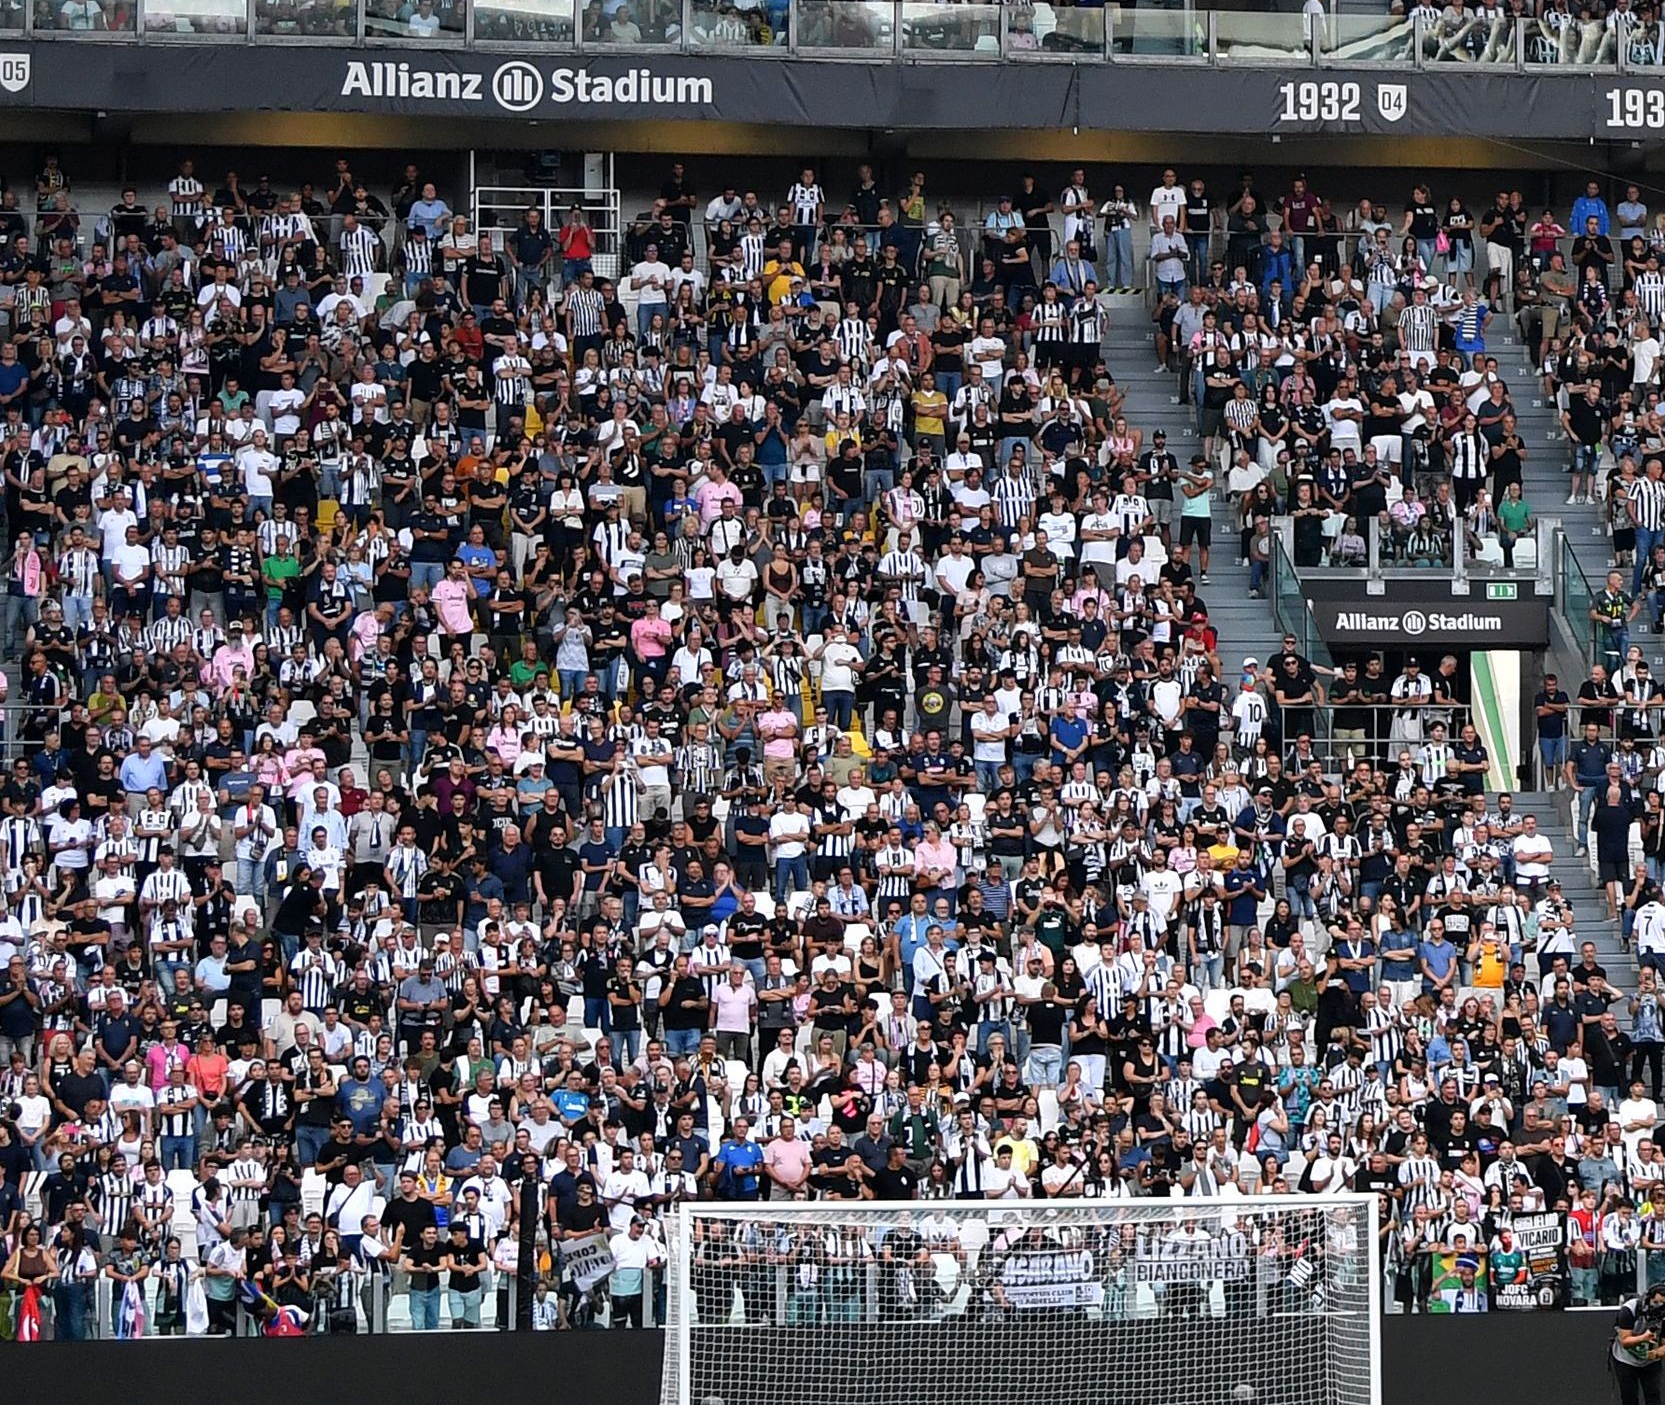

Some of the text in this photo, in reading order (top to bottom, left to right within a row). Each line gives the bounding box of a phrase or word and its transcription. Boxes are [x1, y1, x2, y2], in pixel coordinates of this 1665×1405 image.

[3, 61, 26, 81] 05
[342, 62, 712, 102] Allianz Stadium
[1280, 83, 1404, 120] 1932 04
[1336, 612, 1501, 631] Allianz Stadium
[1248, 703, 1262, 723] 10
[1644, 915, 1653, 936] 7
[1137, 1233, 1246, 1261] LIZZANO
[1518, 1229, 1558, 1247] VICARIO
[1137, 1261, 1247, 1282] BIANCONERA
[1496, 1295, 1537, 1306] NOVARA
